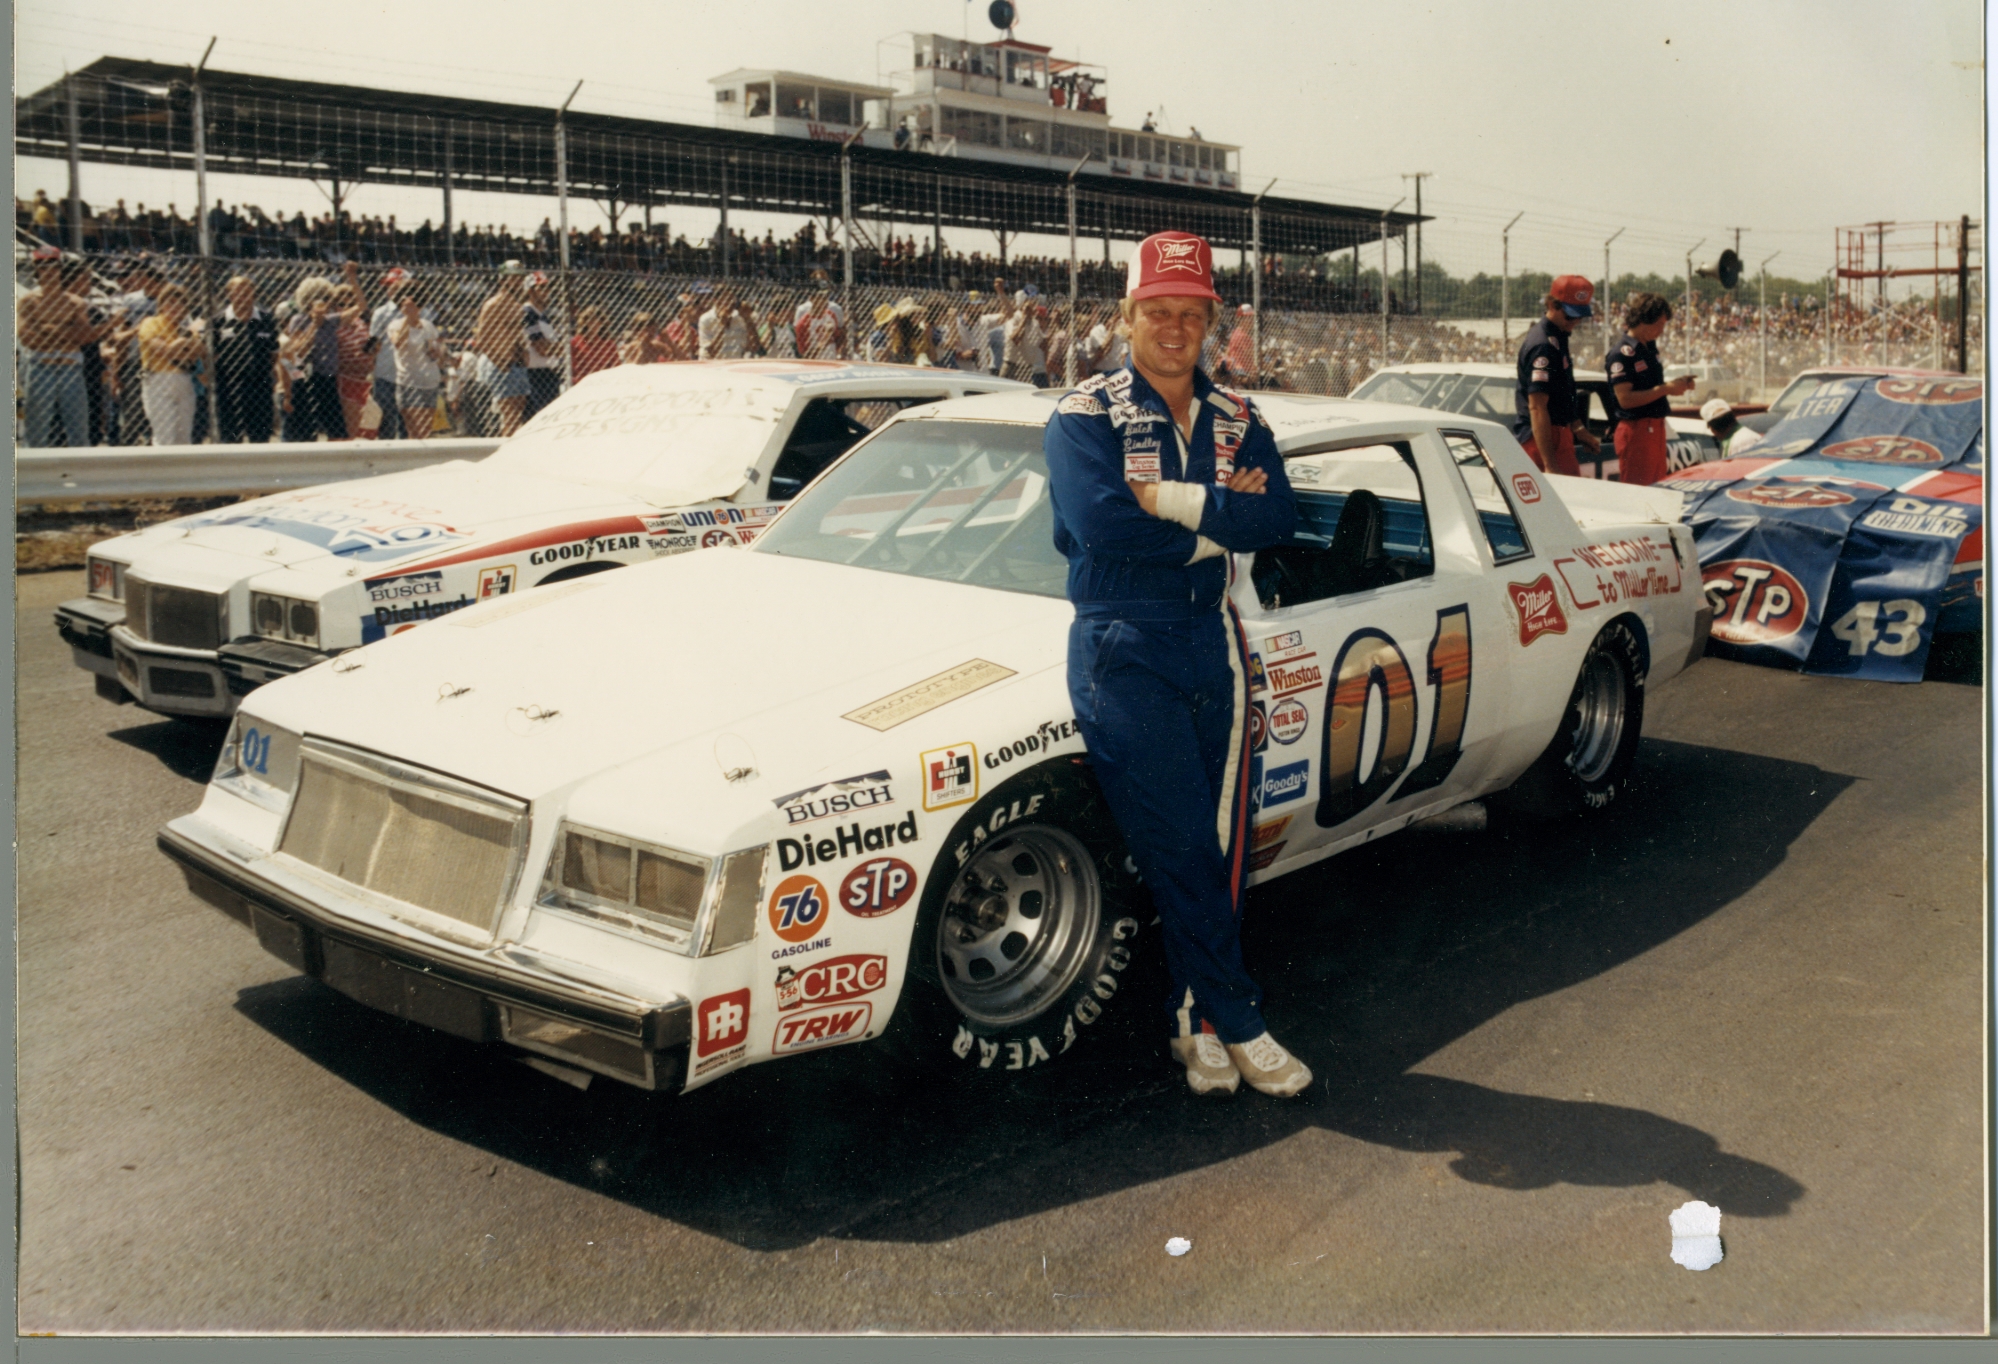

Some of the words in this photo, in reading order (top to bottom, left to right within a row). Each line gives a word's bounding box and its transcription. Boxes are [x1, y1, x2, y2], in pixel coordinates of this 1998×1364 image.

[1162, 243, 1195, 258] Miller
[1123, 437, 1161, 453] Lindley
[1215, 469, 1234, 484] CR
[1517, 479, 1537, 497] ESPN
[646, 518, 682, 529] CHAMPION
[1866, 510, 1968, 537] TREATMENT
[1888, 497, 1969, 520] OIL
[655, 534, 690, 549] MONROE
[1572, 536, 1661, 569] WELCOME
[369, 581, 443, 602] BUSCH
[1596, 575, 1618, 603] to
[1613, 568, 1649, 600] Miller
[1647, 566, 1669, 596] Time
[1703, 566, 1791, 627] STP
[374, 593, 468, 627] DieHard
[1517, 589, 1553, 619] Miller
[1544, 616, 1557, 627] LIFE
[1830, 598, 1927, 657] 43
[856, 662, 990, 721] PROTOTYPE
[1267, 665, 1322, 692] Winston
[1272, 711, 1290, 729] TOTAL
[1291, 708, 1305, 724] SEAL
[1315, 602, 1472, 829] 01
[243, 727, 271, 775] 01
[984, 719, 1082, 770] GOODYEA
[936, 787, 966, 801] SHIFTERS
[1264, 771, 1308, 793] Goody's
[784, 784, 895, 824] BUSCH
[776, 810, 919, 872] DieHard
[954, 794, 1045, 870] EAGLE
[848, 860, 909, 910] STP
[775, 884, 822, 931] 76
[871, 904, 898, 917] TREATMENT
[771, 937, 832, 960] GASOLINE
[798, 958, 885, 1001] CRC
[781, 1008, 866, 1046] TRW
